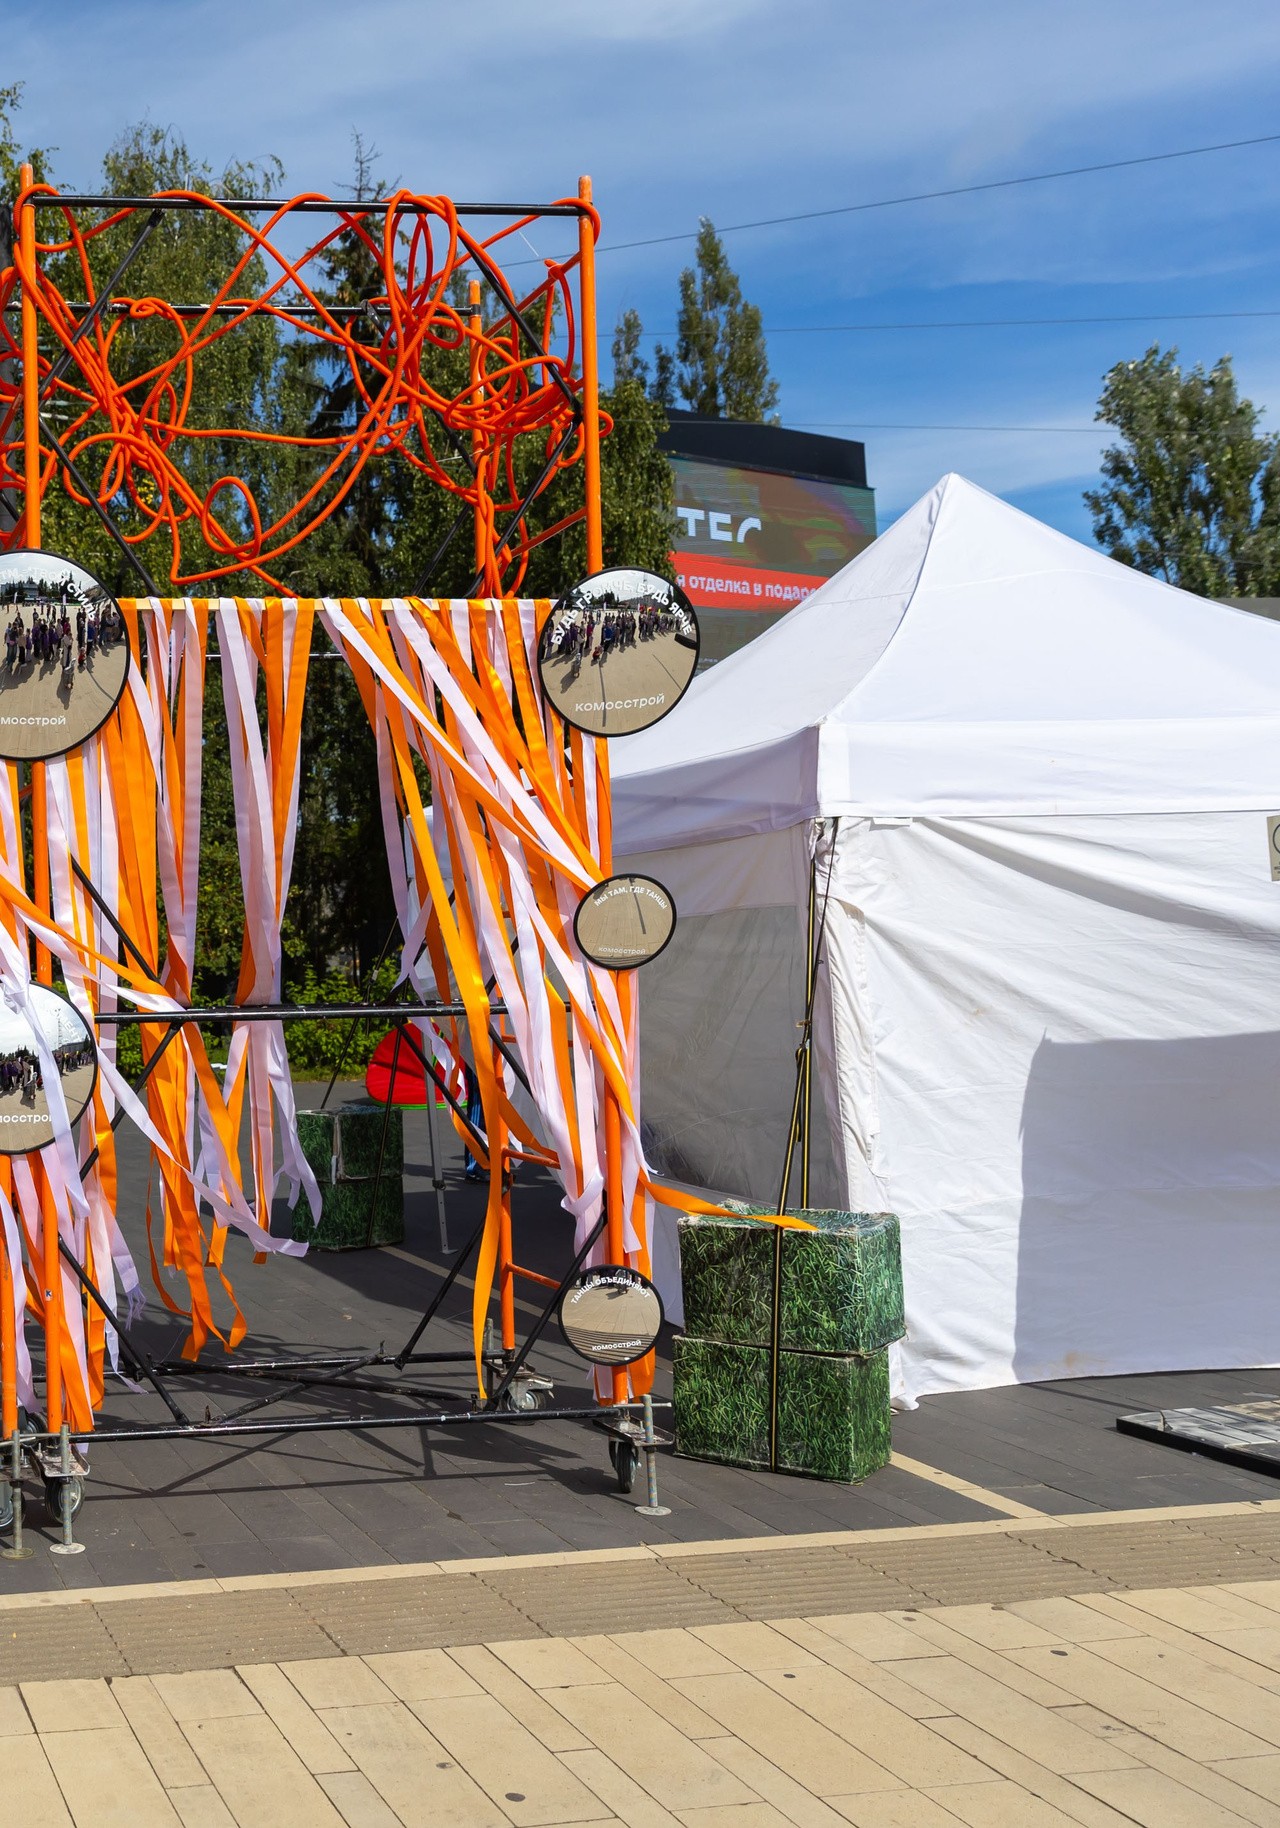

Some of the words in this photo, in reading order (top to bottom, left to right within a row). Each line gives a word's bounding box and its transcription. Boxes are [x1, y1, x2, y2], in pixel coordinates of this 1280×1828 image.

[689, 575, 751, 595] отделка
[753, 583, 762, 596] в
[67, 582, 97, 620] СТИЛЬ
[551, 609, 579, 646] БУДЬ
[637, 582, 670, 605] БУДЬ
[668, 601, 693, 636] ЯРЧЕ
[593, 894, 608, 906] МЫ
[629, 885, 645, 894] ГДЕ
[646, 888, 667, 909] ТАНЦЫ
[570, 1281, 595, 1304] ТАНЦЫ
[595, 1276, 651, 1298] ОБЪЕДИНЯЮТ
